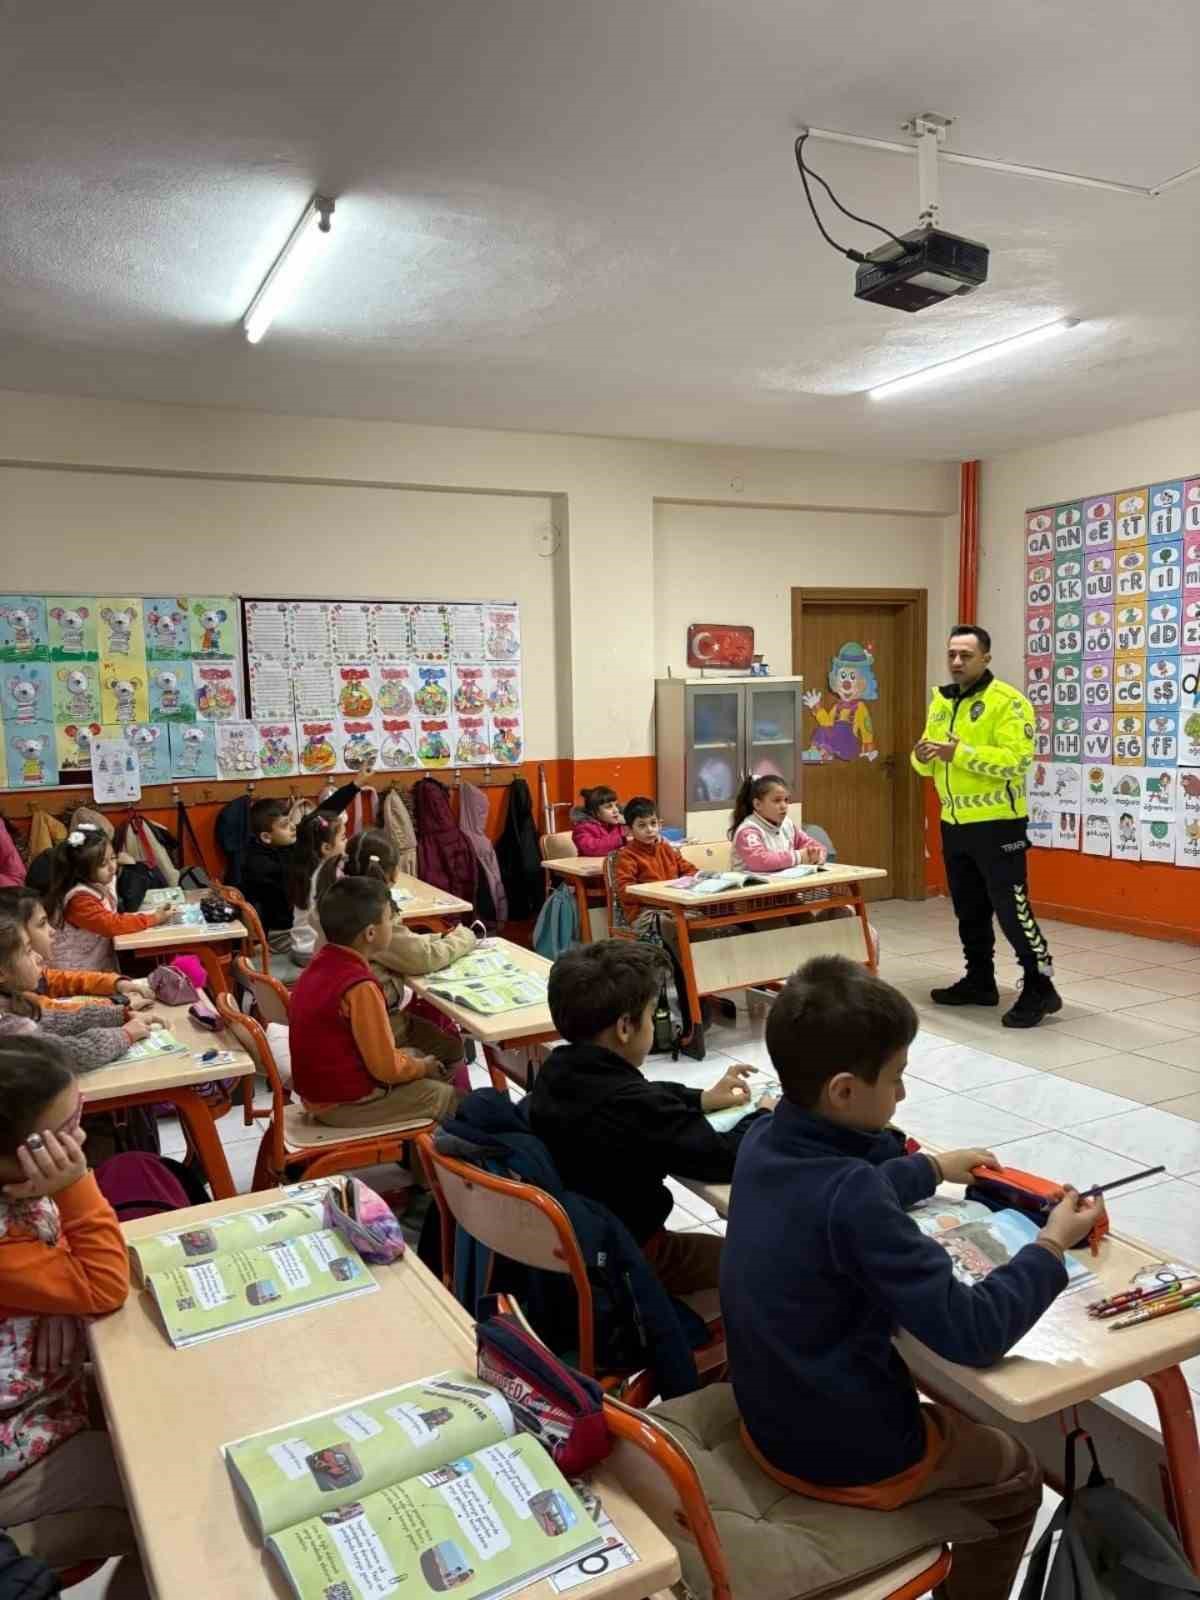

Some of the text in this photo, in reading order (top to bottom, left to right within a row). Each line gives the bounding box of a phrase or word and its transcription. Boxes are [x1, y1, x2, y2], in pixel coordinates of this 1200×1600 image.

[1088, 522, 1109, 542] eE
[1121, 516, 1142, 536] tT
[1029, 533, 1050, 552] aA
[1056, 527, 1081, 548] nN
[1058, 580, 1080, 599] kK
[1087, 576, 1112, 595] uU
[1120, 572, 1142, 591] rR
[1029, 584, 1050, 602] oO
[1119, 626, 1141, 649] yY
[1150, 626, 1177, 644] dD
